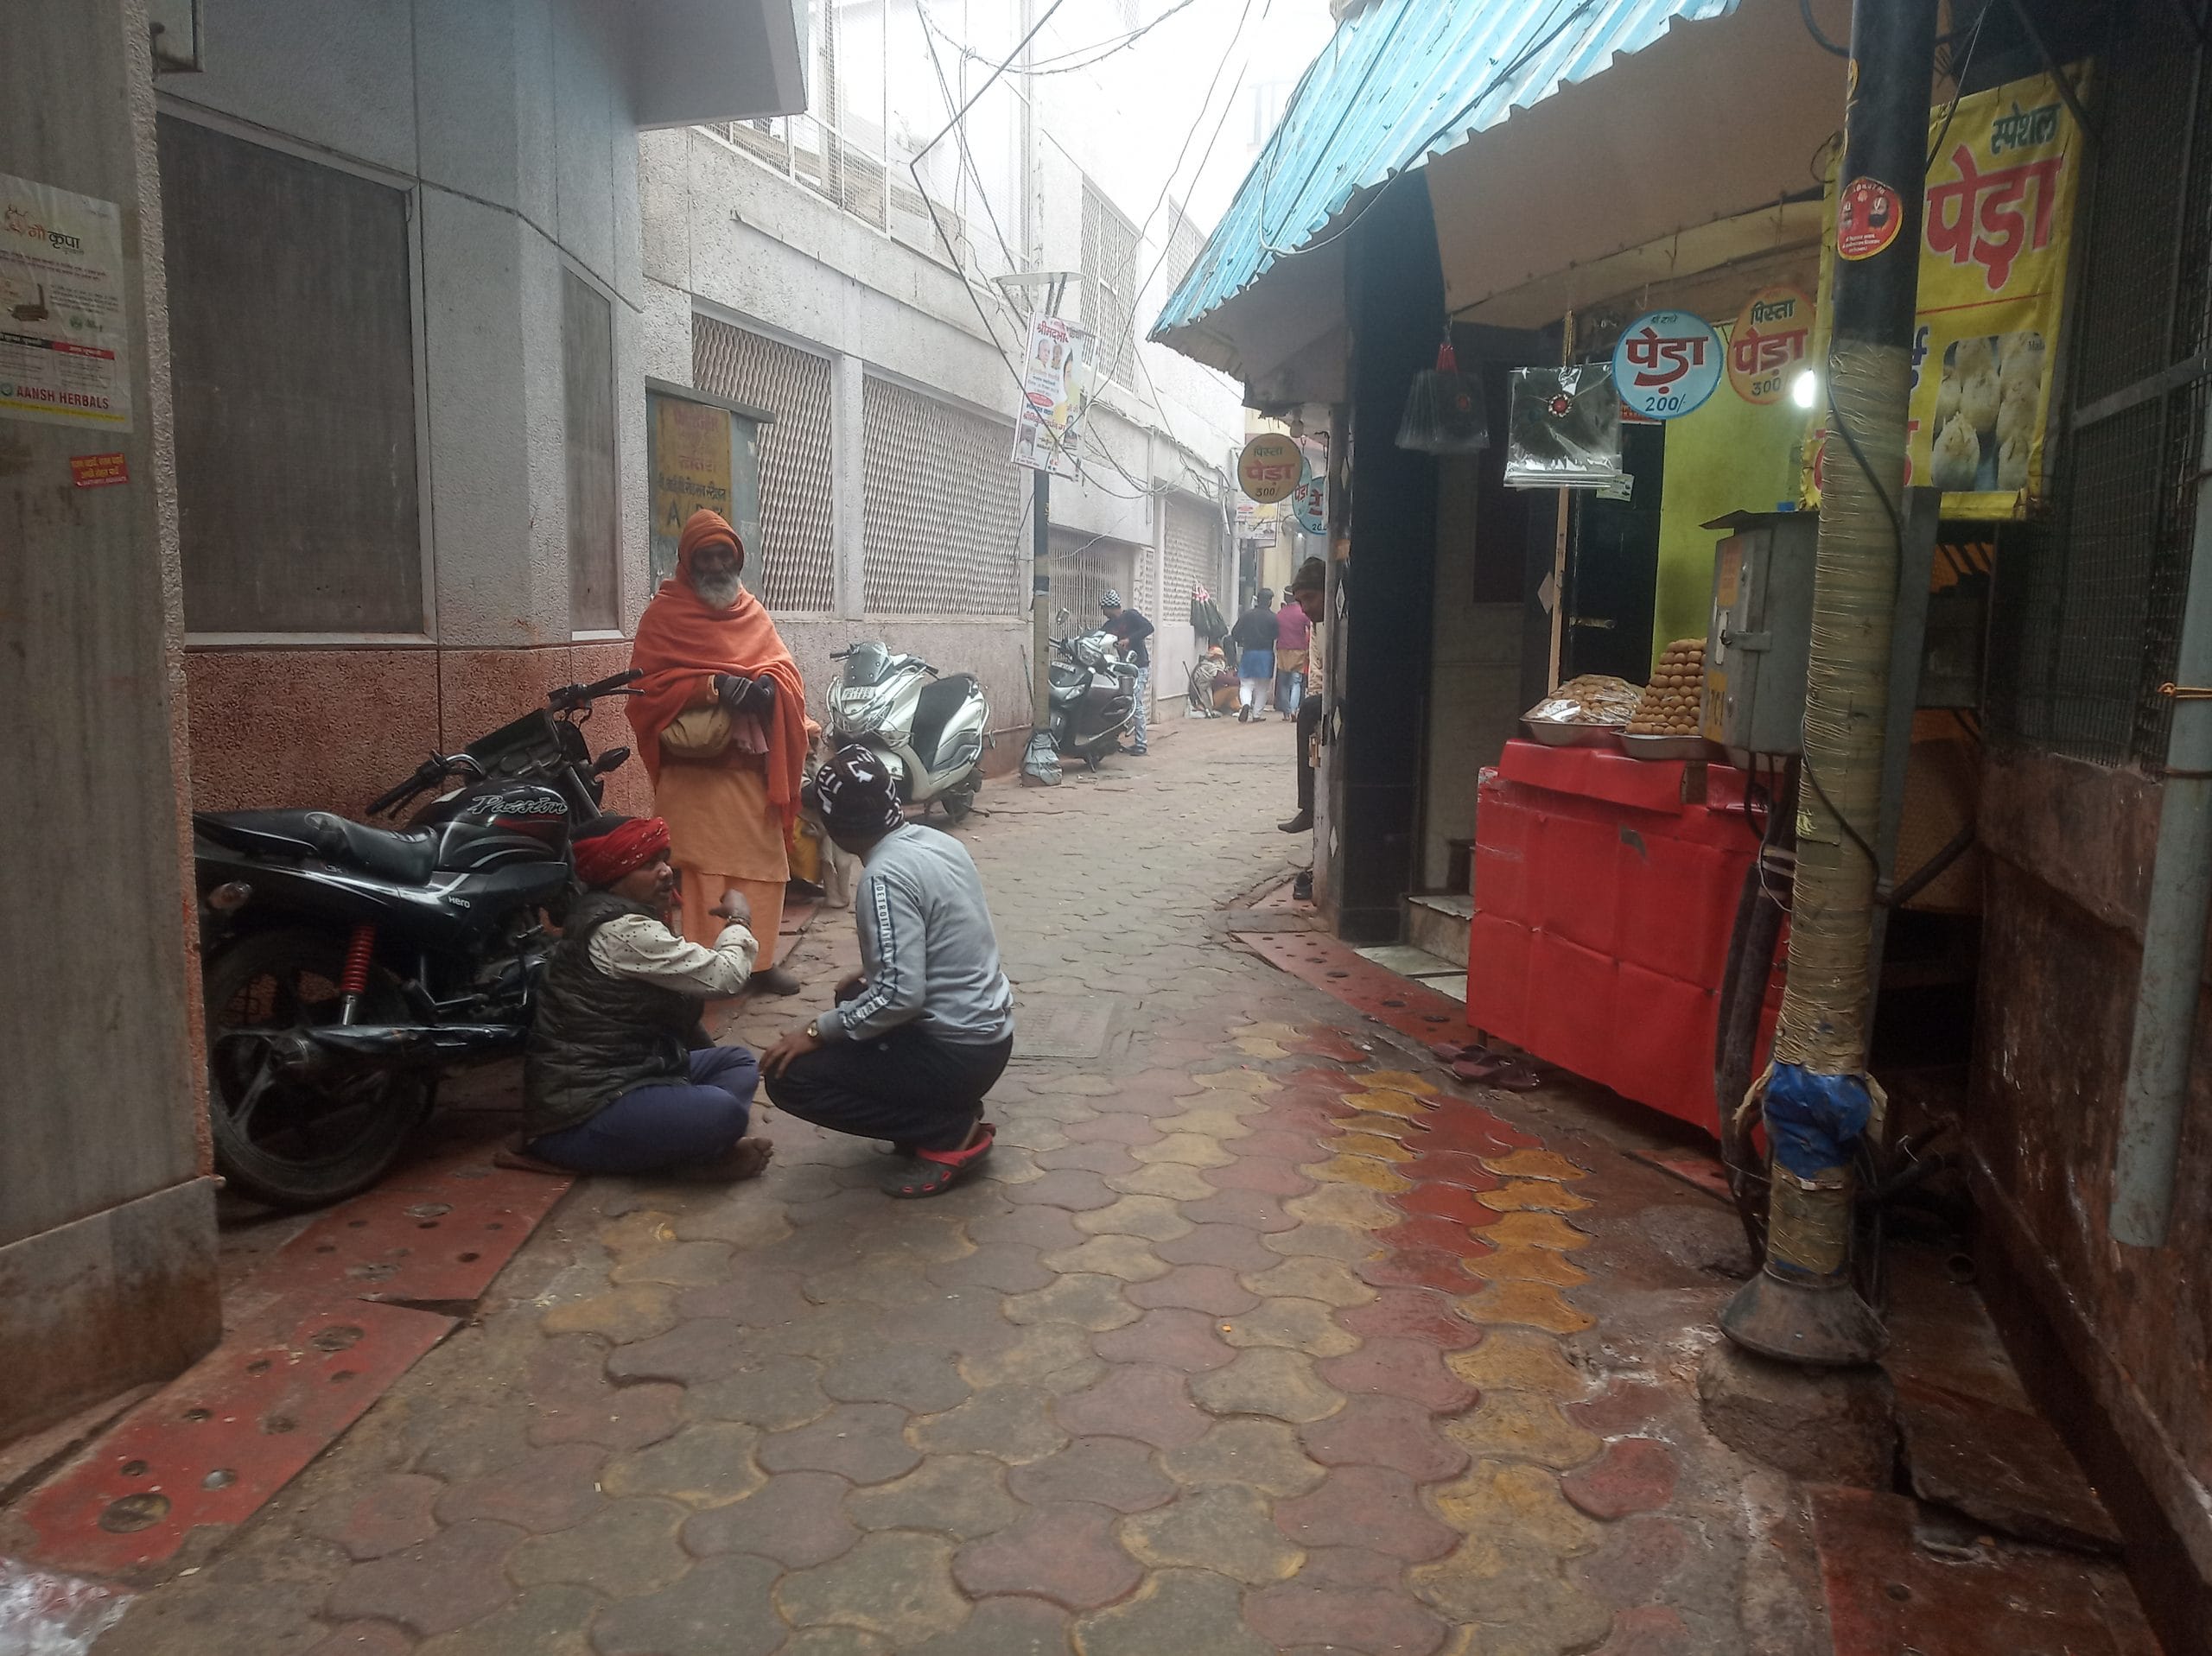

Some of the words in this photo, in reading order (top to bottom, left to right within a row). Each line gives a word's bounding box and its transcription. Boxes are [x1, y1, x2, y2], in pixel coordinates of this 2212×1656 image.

[1992, 102, 2062, 155] स्पेशल
[1926, 144, 2065, 290] पेड़ा
[47, 231, 81, 249] कृपा
[1751, 298, 1796, 325] पिस्ता
[1625, 327, 1709, 395] पेड़ा
[1733, 327, 1809, 377] पेड़ा
[16, 385, 55, 403] AANSH
[60, 392, 110, 409] HERBALS
[1244, 459, 1295, 485] पेड़ा
[467, 795, 568, 815] Passion
[876, 885, 889, 927] DETROIT
